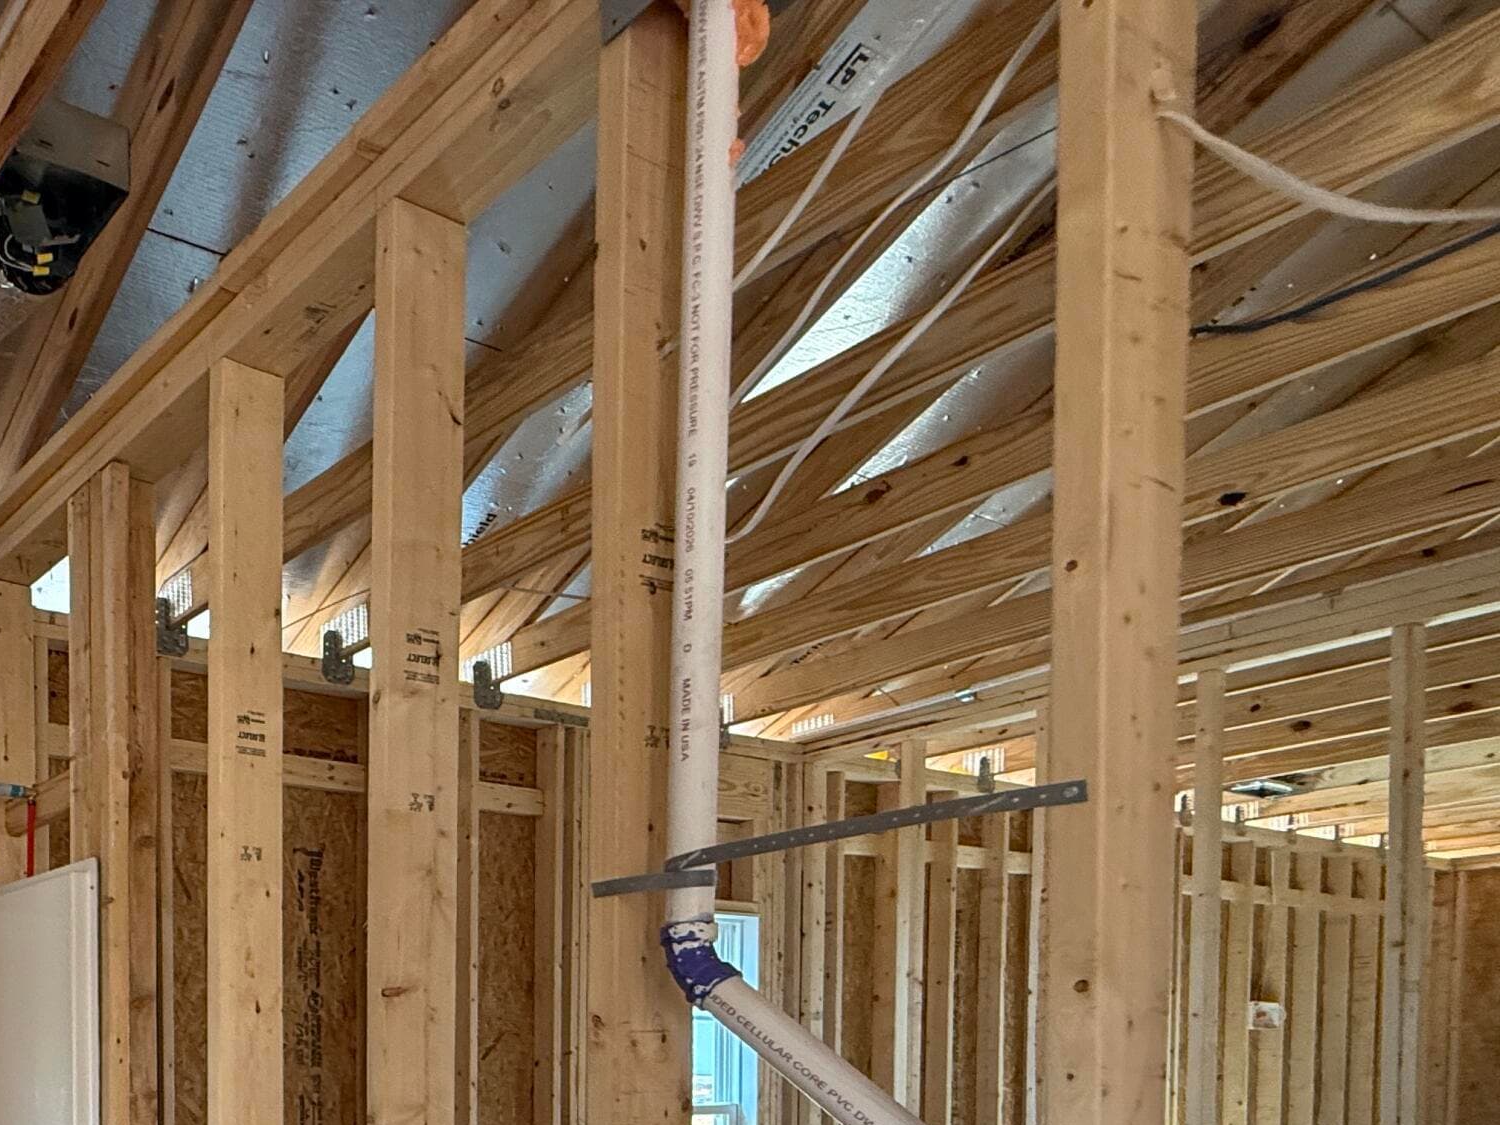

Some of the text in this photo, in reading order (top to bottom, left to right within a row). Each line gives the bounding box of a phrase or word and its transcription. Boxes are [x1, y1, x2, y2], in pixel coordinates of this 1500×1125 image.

[841, 52, 870, 85] LP
[696, 71, 707, 110] ASTM
[690, 303, 701, 331] NOT
[690, 336, 700, 365] FOR
[688, 367, 700, 437] PRESSURE
[680, 678, 691, 715] MADE
[680, 717, 690, 732] IN
[680, 735, 690, 762] USA
[736, 1012, 793, 1064] CELLULAR
[793, 1059, 829, 1091] CORE
[826, 1088, 855, 1113] PVC
